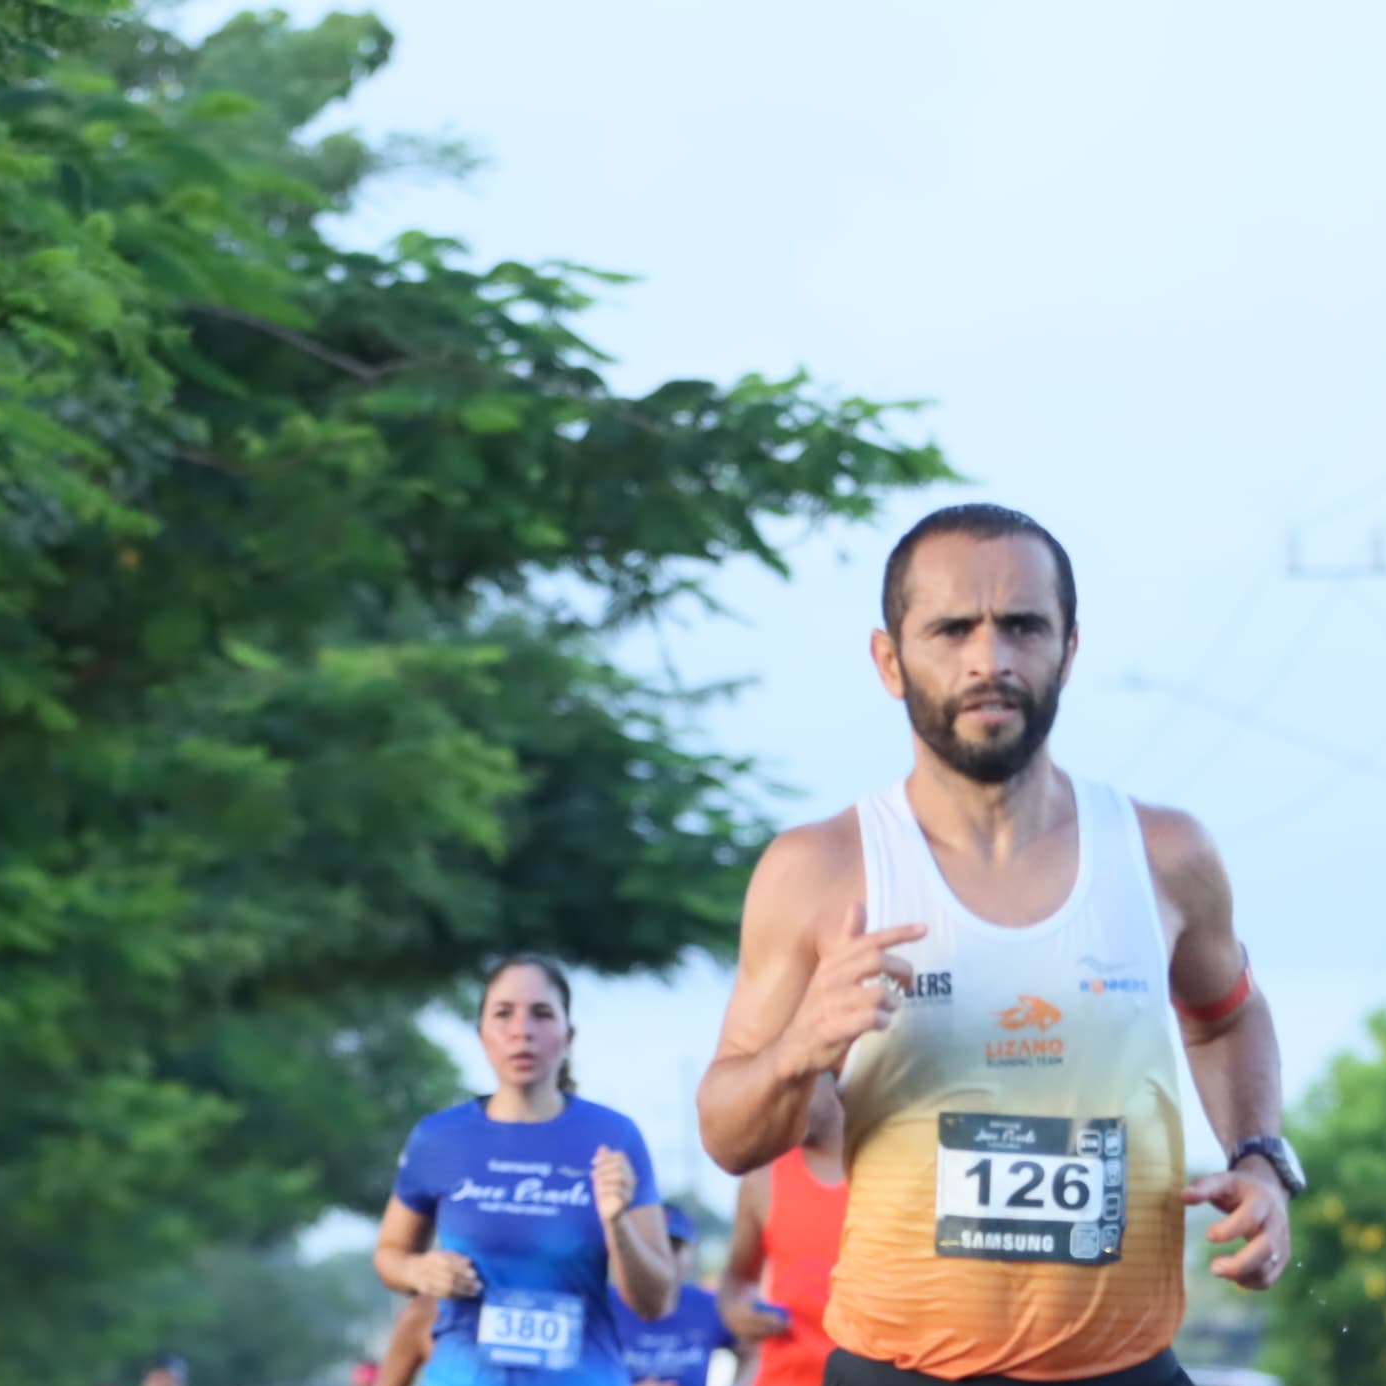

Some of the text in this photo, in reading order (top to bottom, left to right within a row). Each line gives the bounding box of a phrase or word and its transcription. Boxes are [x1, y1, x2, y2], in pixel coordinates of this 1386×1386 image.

[904, 972, 952, 998] ERS
[985, 1038, 1065, 1058] LIZANO
[965, 1158, 1091, 1211] 126
[960, 1230, 1055, 1253] SAMSUNG
[494, 1311, 560, 1342] 380
